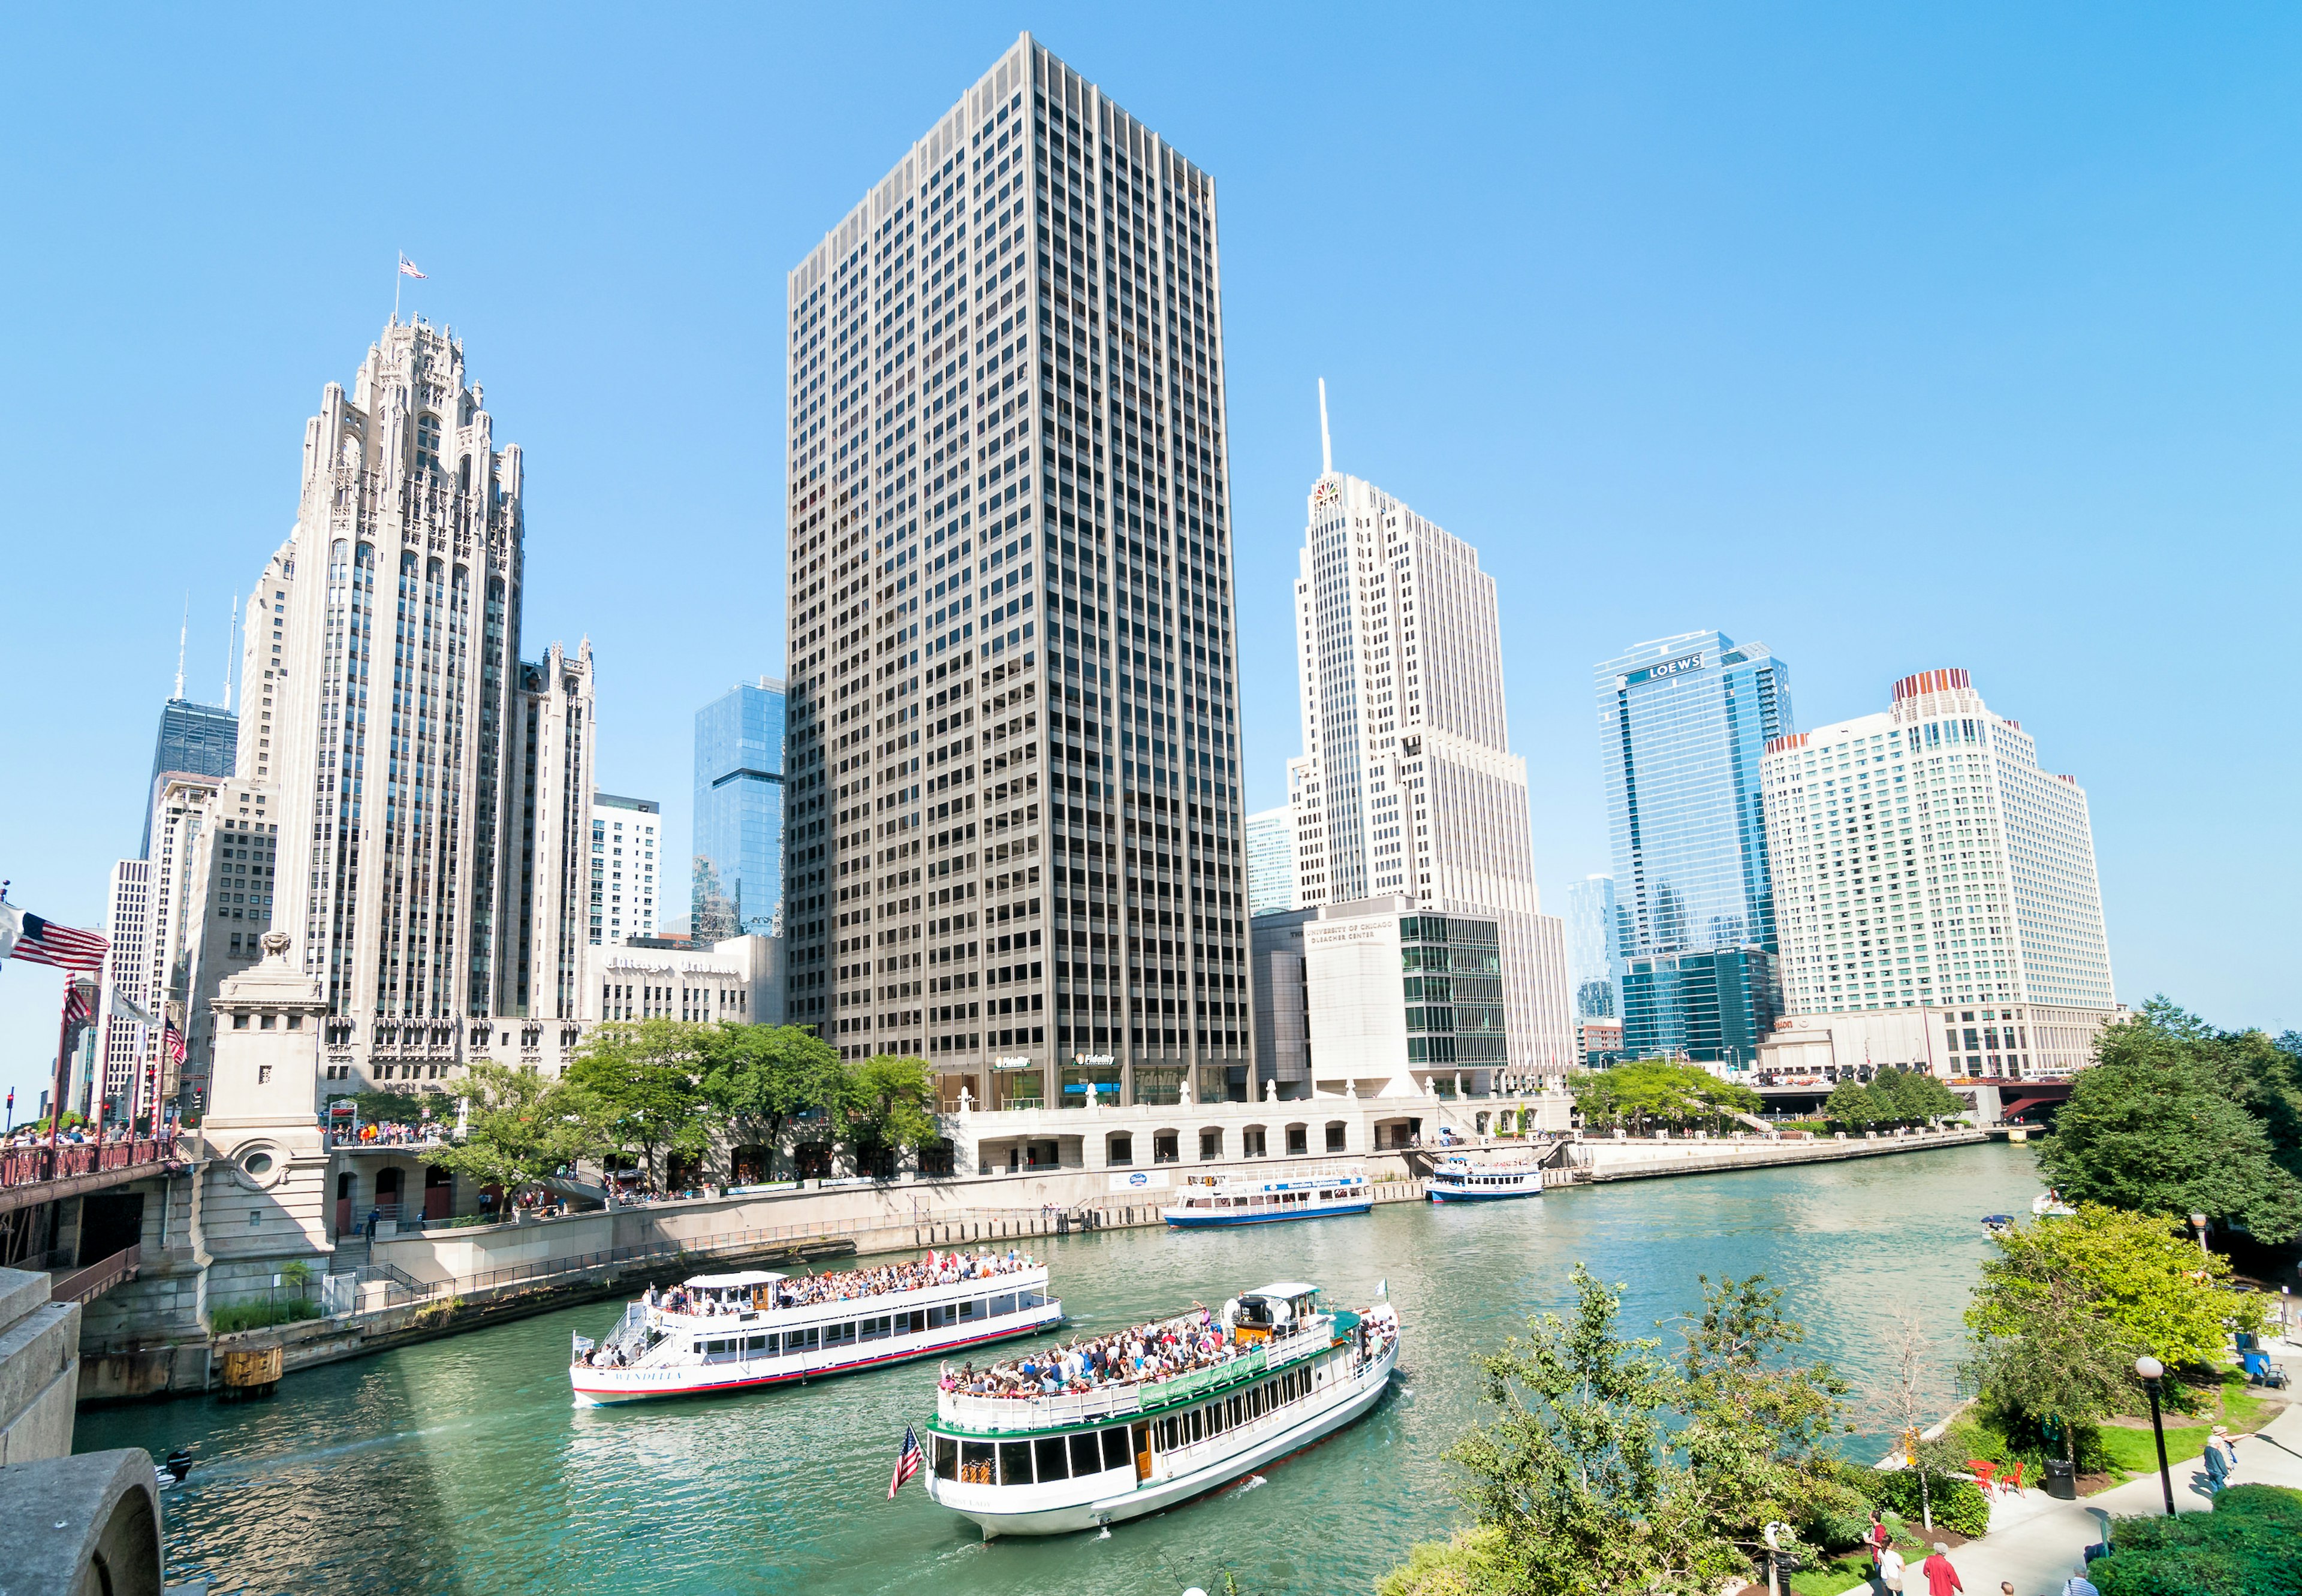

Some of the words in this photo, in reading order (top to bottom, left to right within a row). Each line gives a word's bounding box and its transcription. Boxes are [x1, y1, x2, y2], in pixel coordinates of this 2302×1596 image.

[1649, 655, 1700, 678] LOEWS
[1306, 926, 1346, 936] UNIVERSITY
[1360, 921, 1393, 930] CHICAGO
[1311, 934, 1346, 943] GLEACHER
[602, 952, 670, 973] Chicago
[679, 957, 738, 975] Tribune
[1002, 1055, 1029, 1066] Fidelity
[1084, 1054, 1114, 1065] Fidelity
[1133, 1070, 1186, 1087] Fidelity
[384, 1082, 416, 1094] WGN
[1312, 1179, 1341, 1188] Sightseeing
[616, 1372, 681, 1380] WENDELLA
[1142, 1391, 1167, 1401] Welcome
[969, 1499, 991, 1507] LADY
